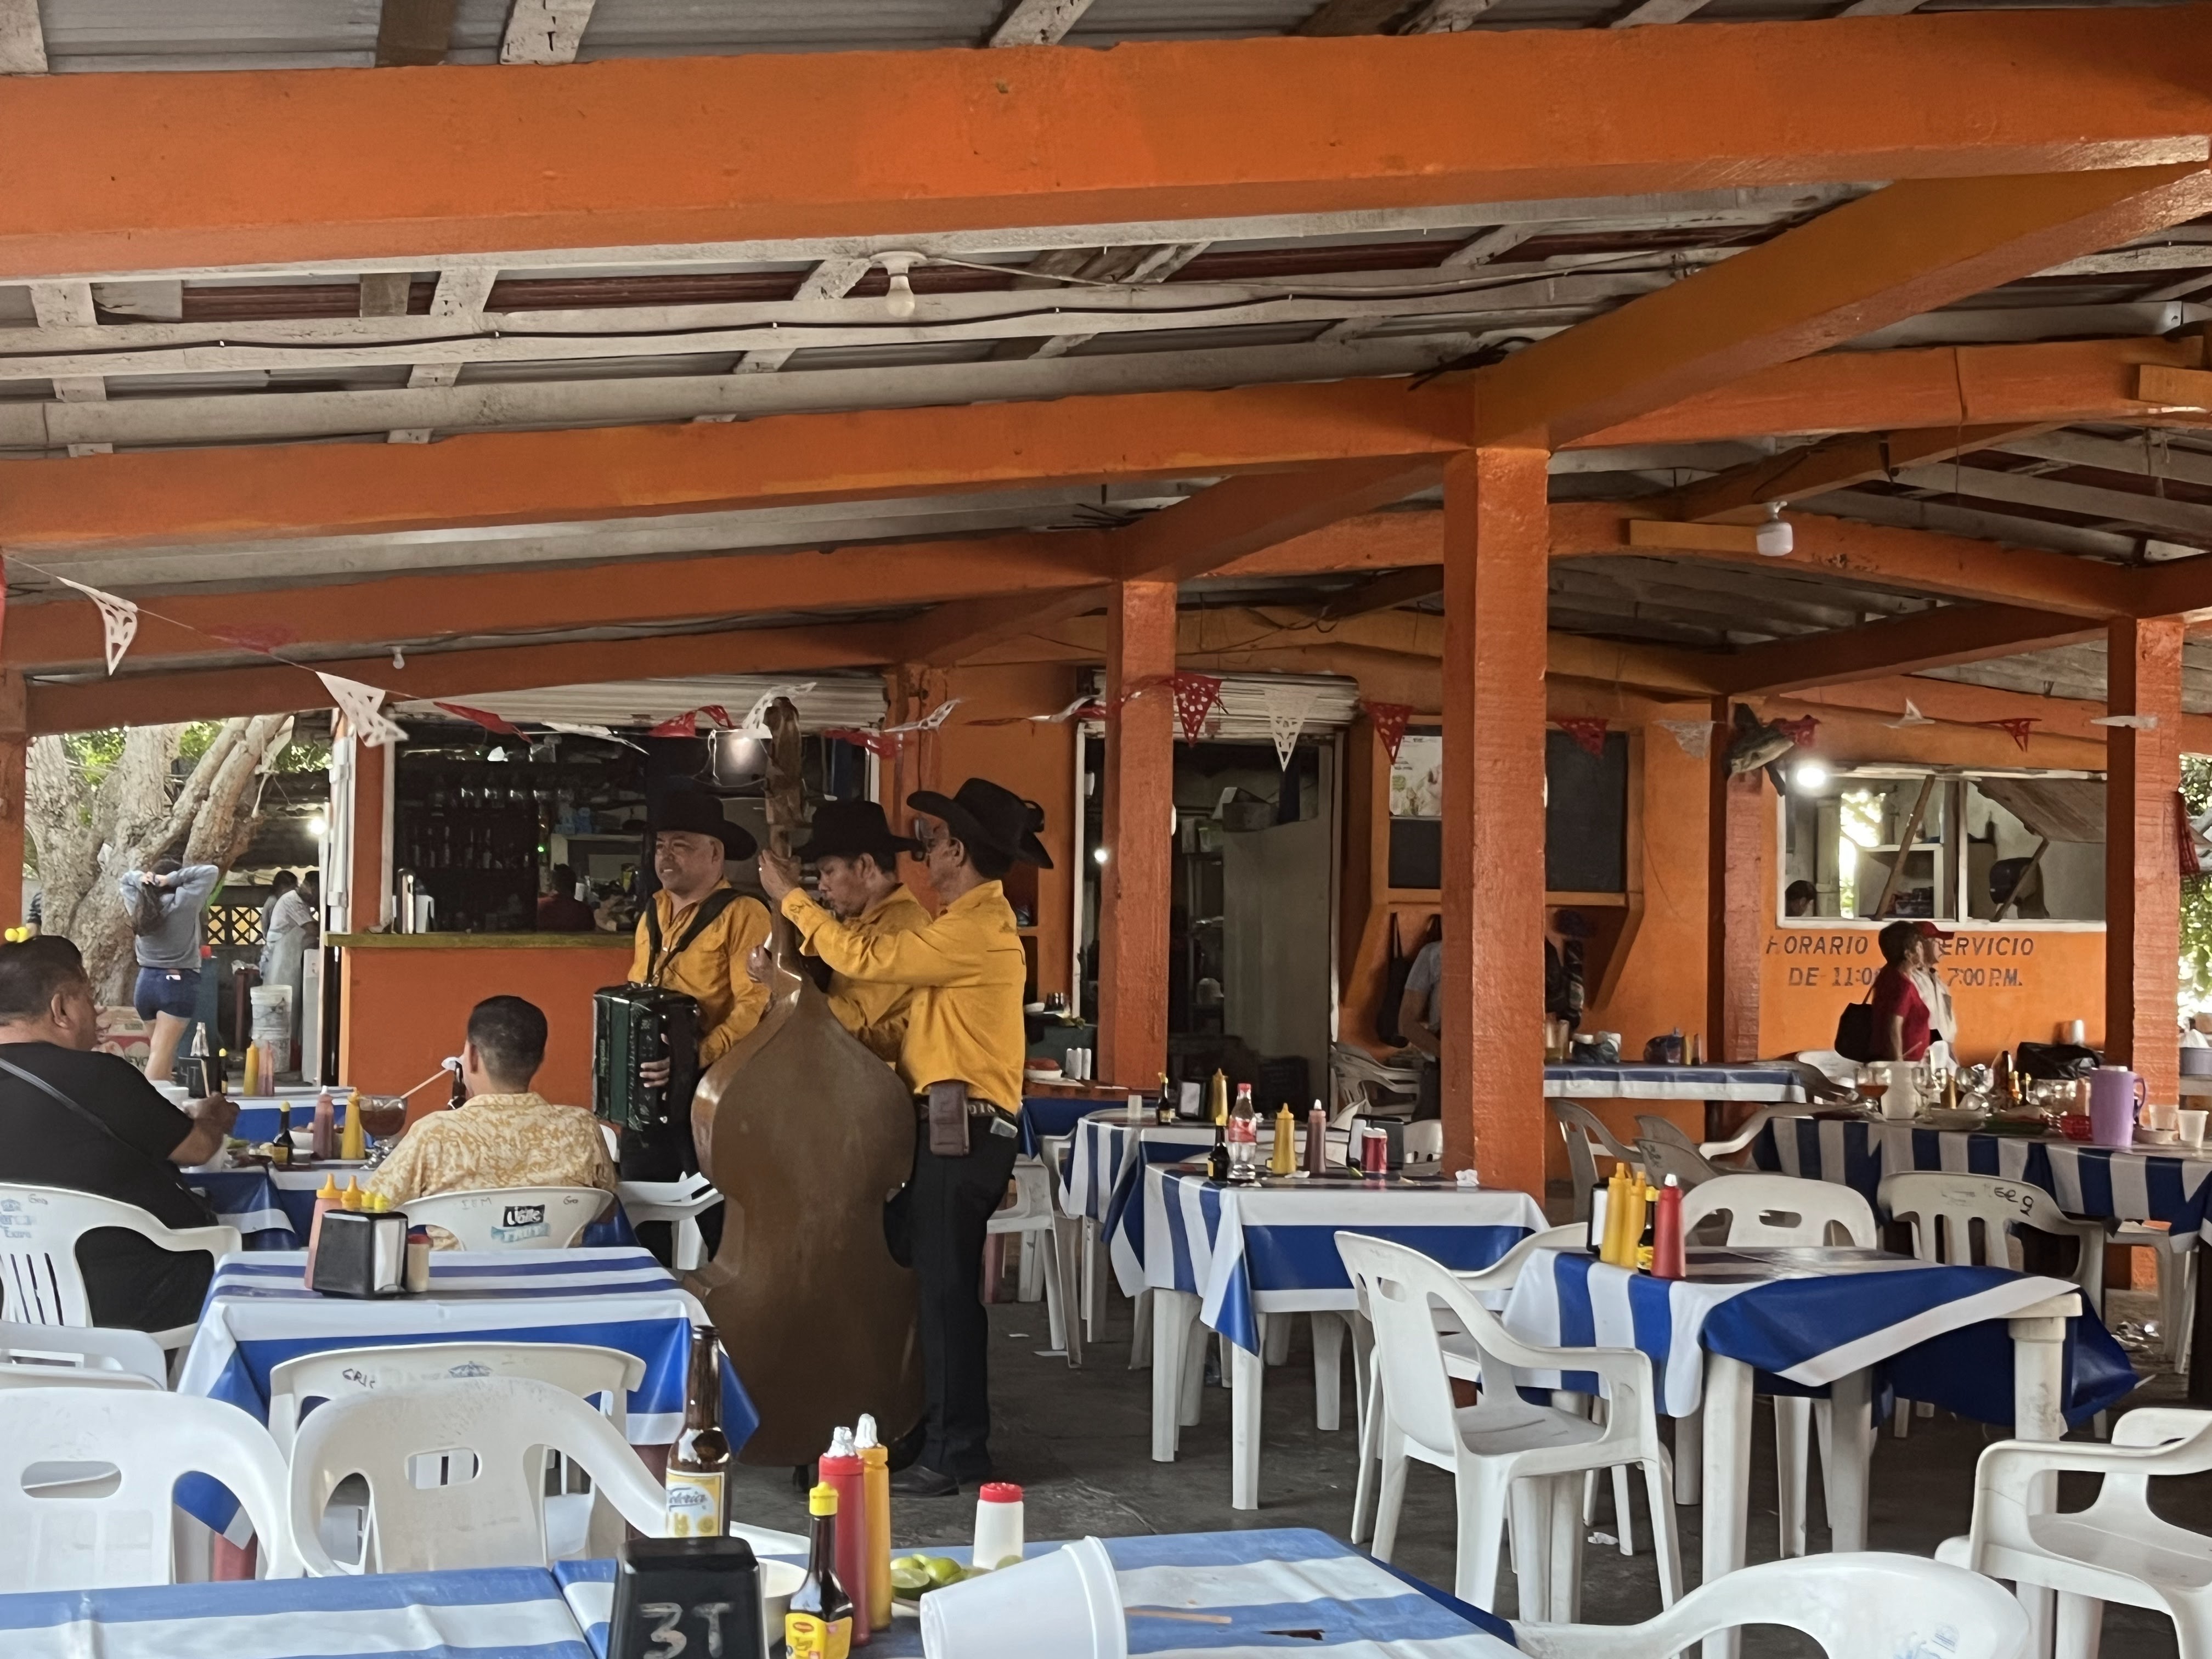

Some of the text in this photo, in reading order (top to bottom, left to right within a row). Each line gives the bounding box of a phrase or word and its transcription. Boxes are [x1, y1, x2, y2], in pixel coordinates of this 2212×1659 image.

[1939, 936, 2034, 956] ERVICIO
[1788, 967, 1820, 986] DE
[1832, 967, 1873, 986] 11:0
[640, 1602, 736, 1659] 3T
